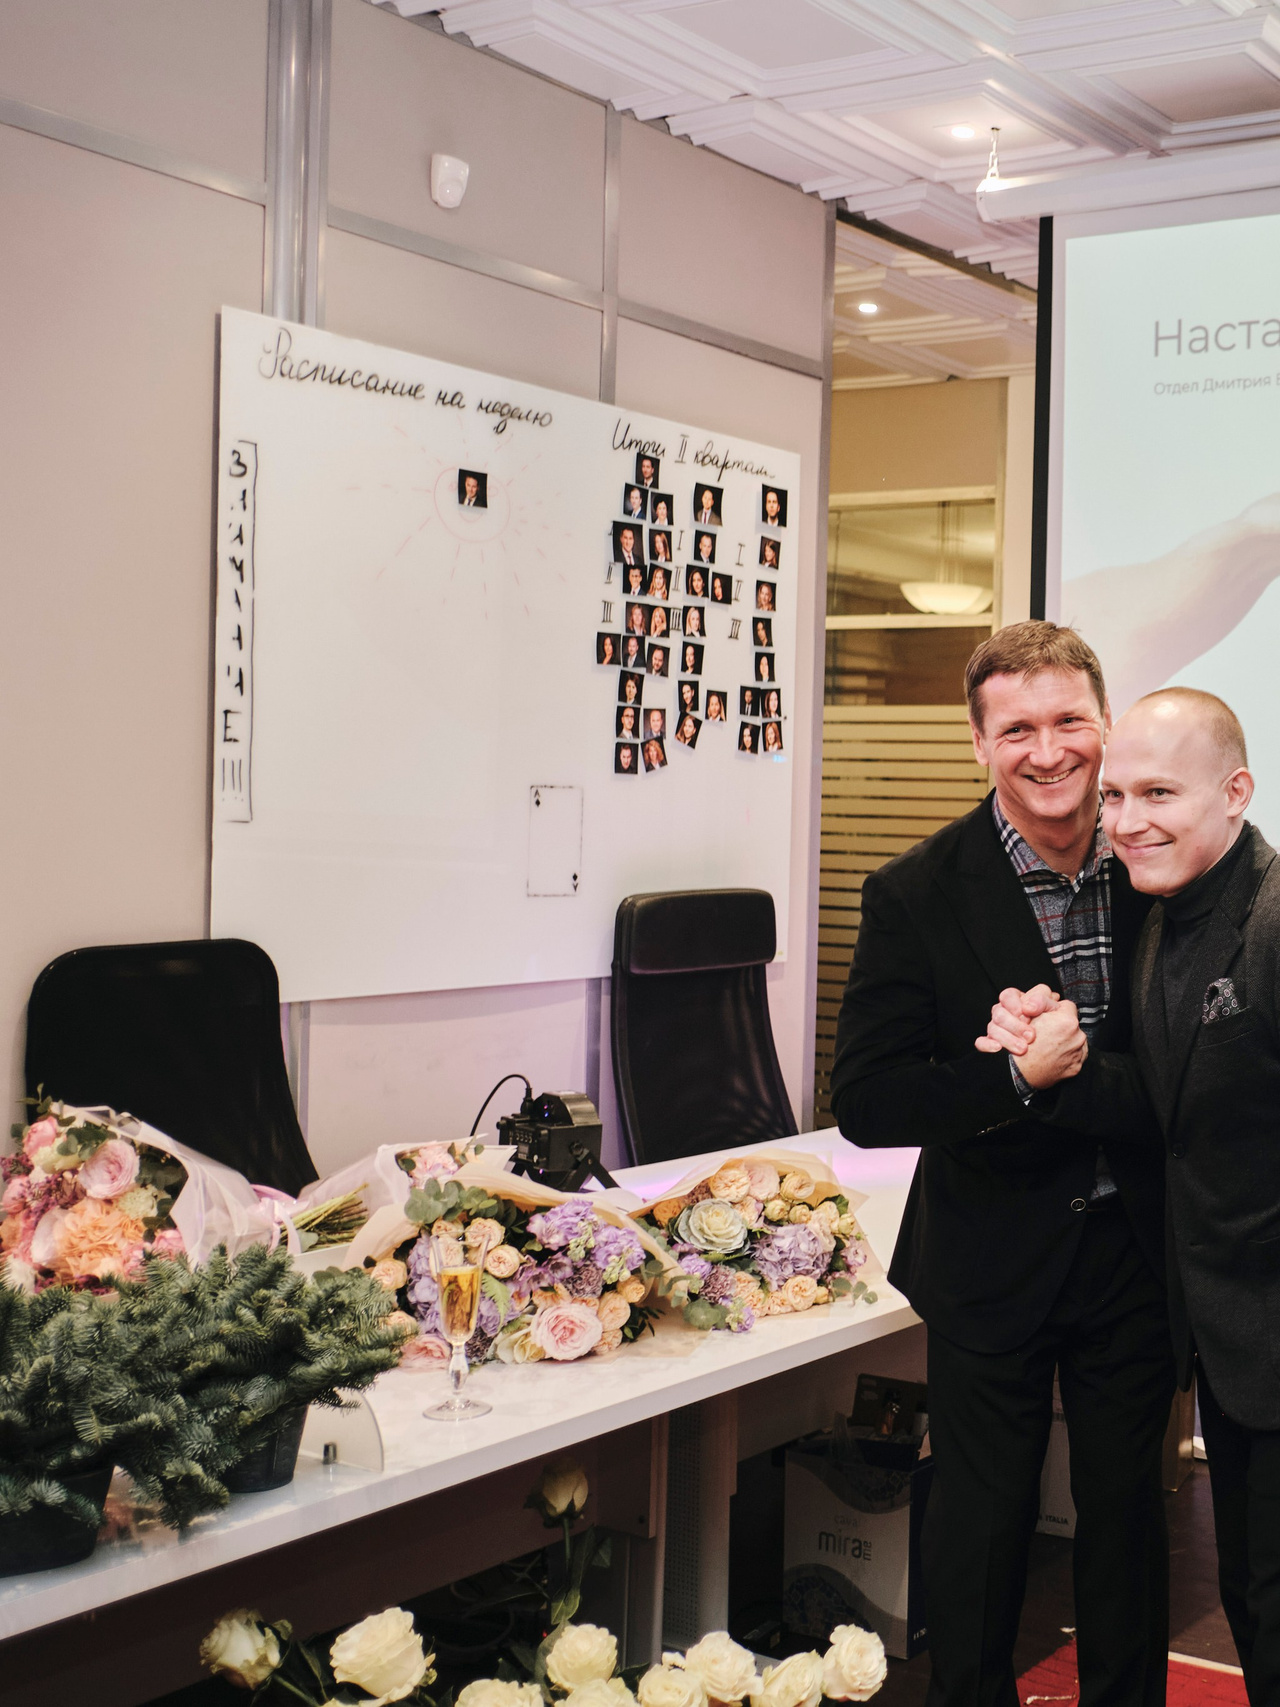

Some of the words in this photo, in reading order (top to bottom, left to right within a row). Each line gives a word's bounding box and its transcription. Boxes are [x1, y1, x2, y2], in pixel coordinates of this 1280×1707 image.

[258, 327, 425, 400] Расписание
[435, 388, 466, 409] на
[476, 397, 553, 435] неделю
[1154, 380, 1199, 396] Отдел
[1202, 375, 1271, 394] Дмитрия
[612, 418, 666, 458] Итоги
[1045, 1514, 1069, 1525] ITALIA
[818, 1529, 863, 1559] mira
